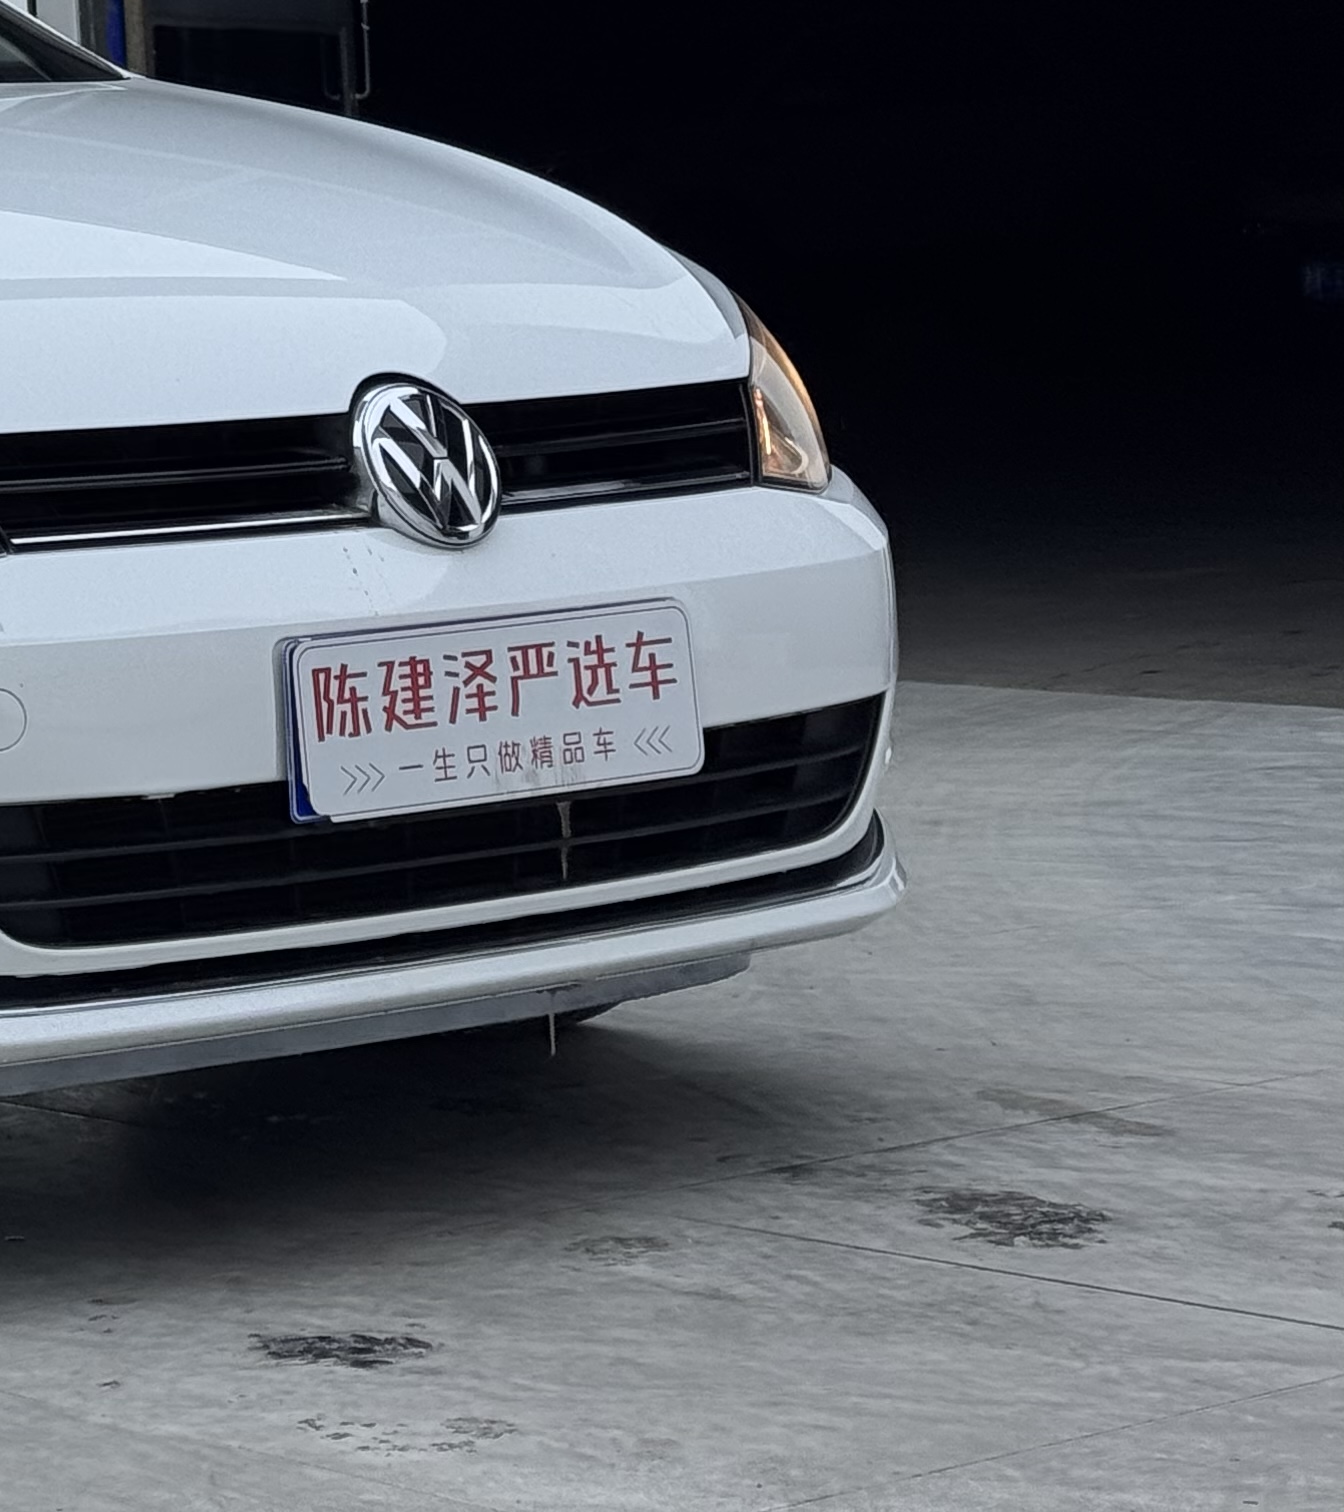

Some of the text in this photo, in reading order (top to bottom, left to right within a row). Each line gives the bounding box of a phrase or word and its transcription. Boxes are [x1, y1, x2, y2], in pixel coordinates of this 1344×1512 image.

[312, 631, 678, 742] 陈建泽严选车
[398, 727, 618, 783] 一生只做精品车
